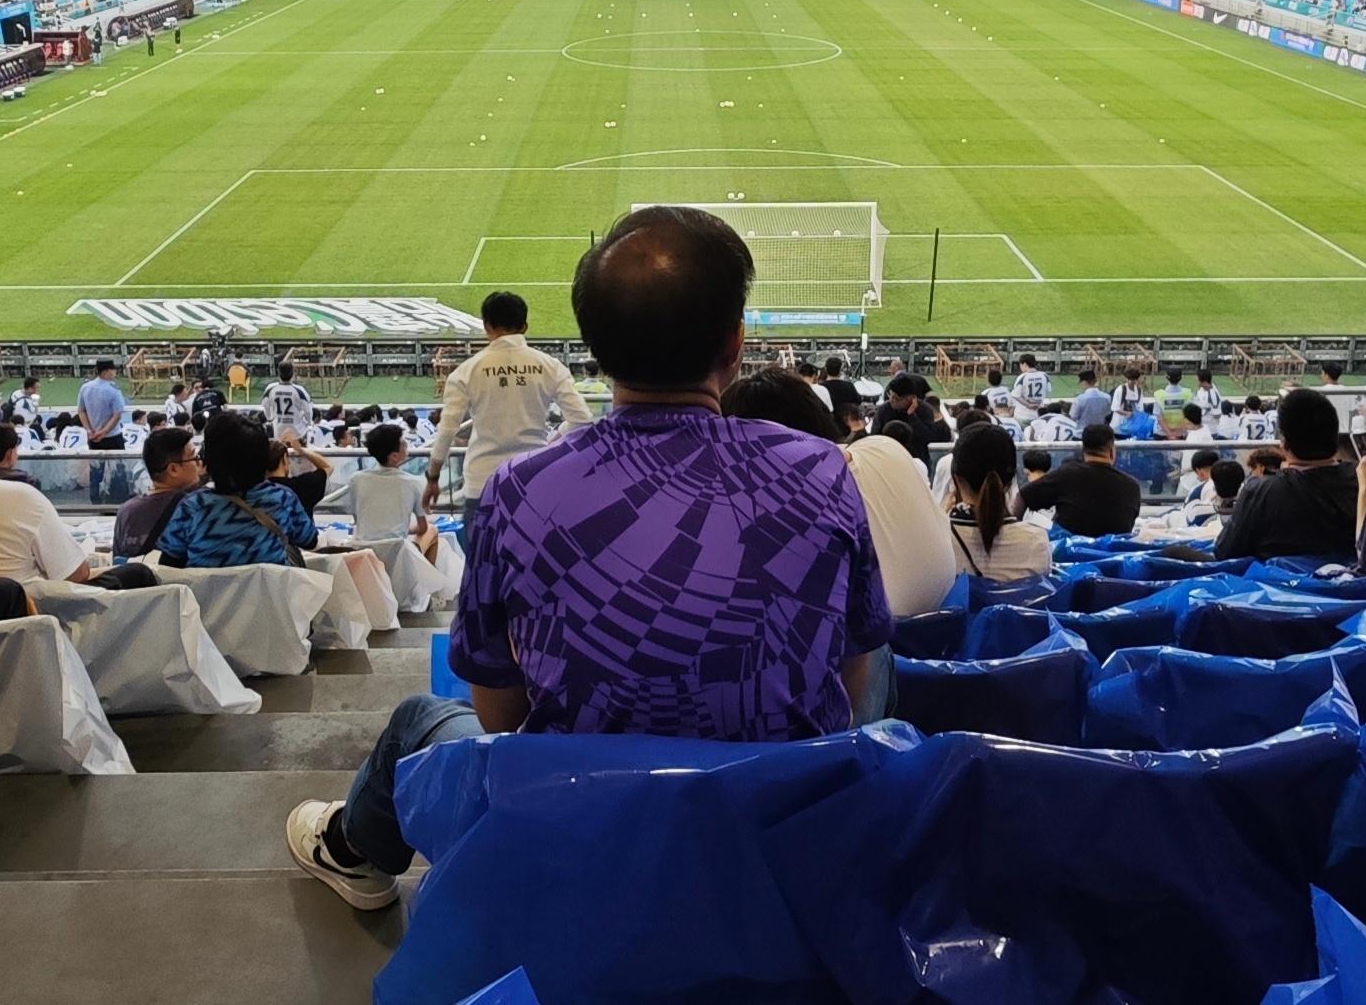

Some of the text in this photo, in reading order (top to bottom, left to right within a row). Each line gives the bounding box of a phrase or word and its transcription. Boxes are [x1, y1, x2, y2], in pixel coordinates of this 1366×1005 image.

[482, 362, 545, 378] TIANJIN
[1027, 382, 1043, 398] 12
[273, 397, 295, 416] 12
[1245, 423, 1266, 440] 12
